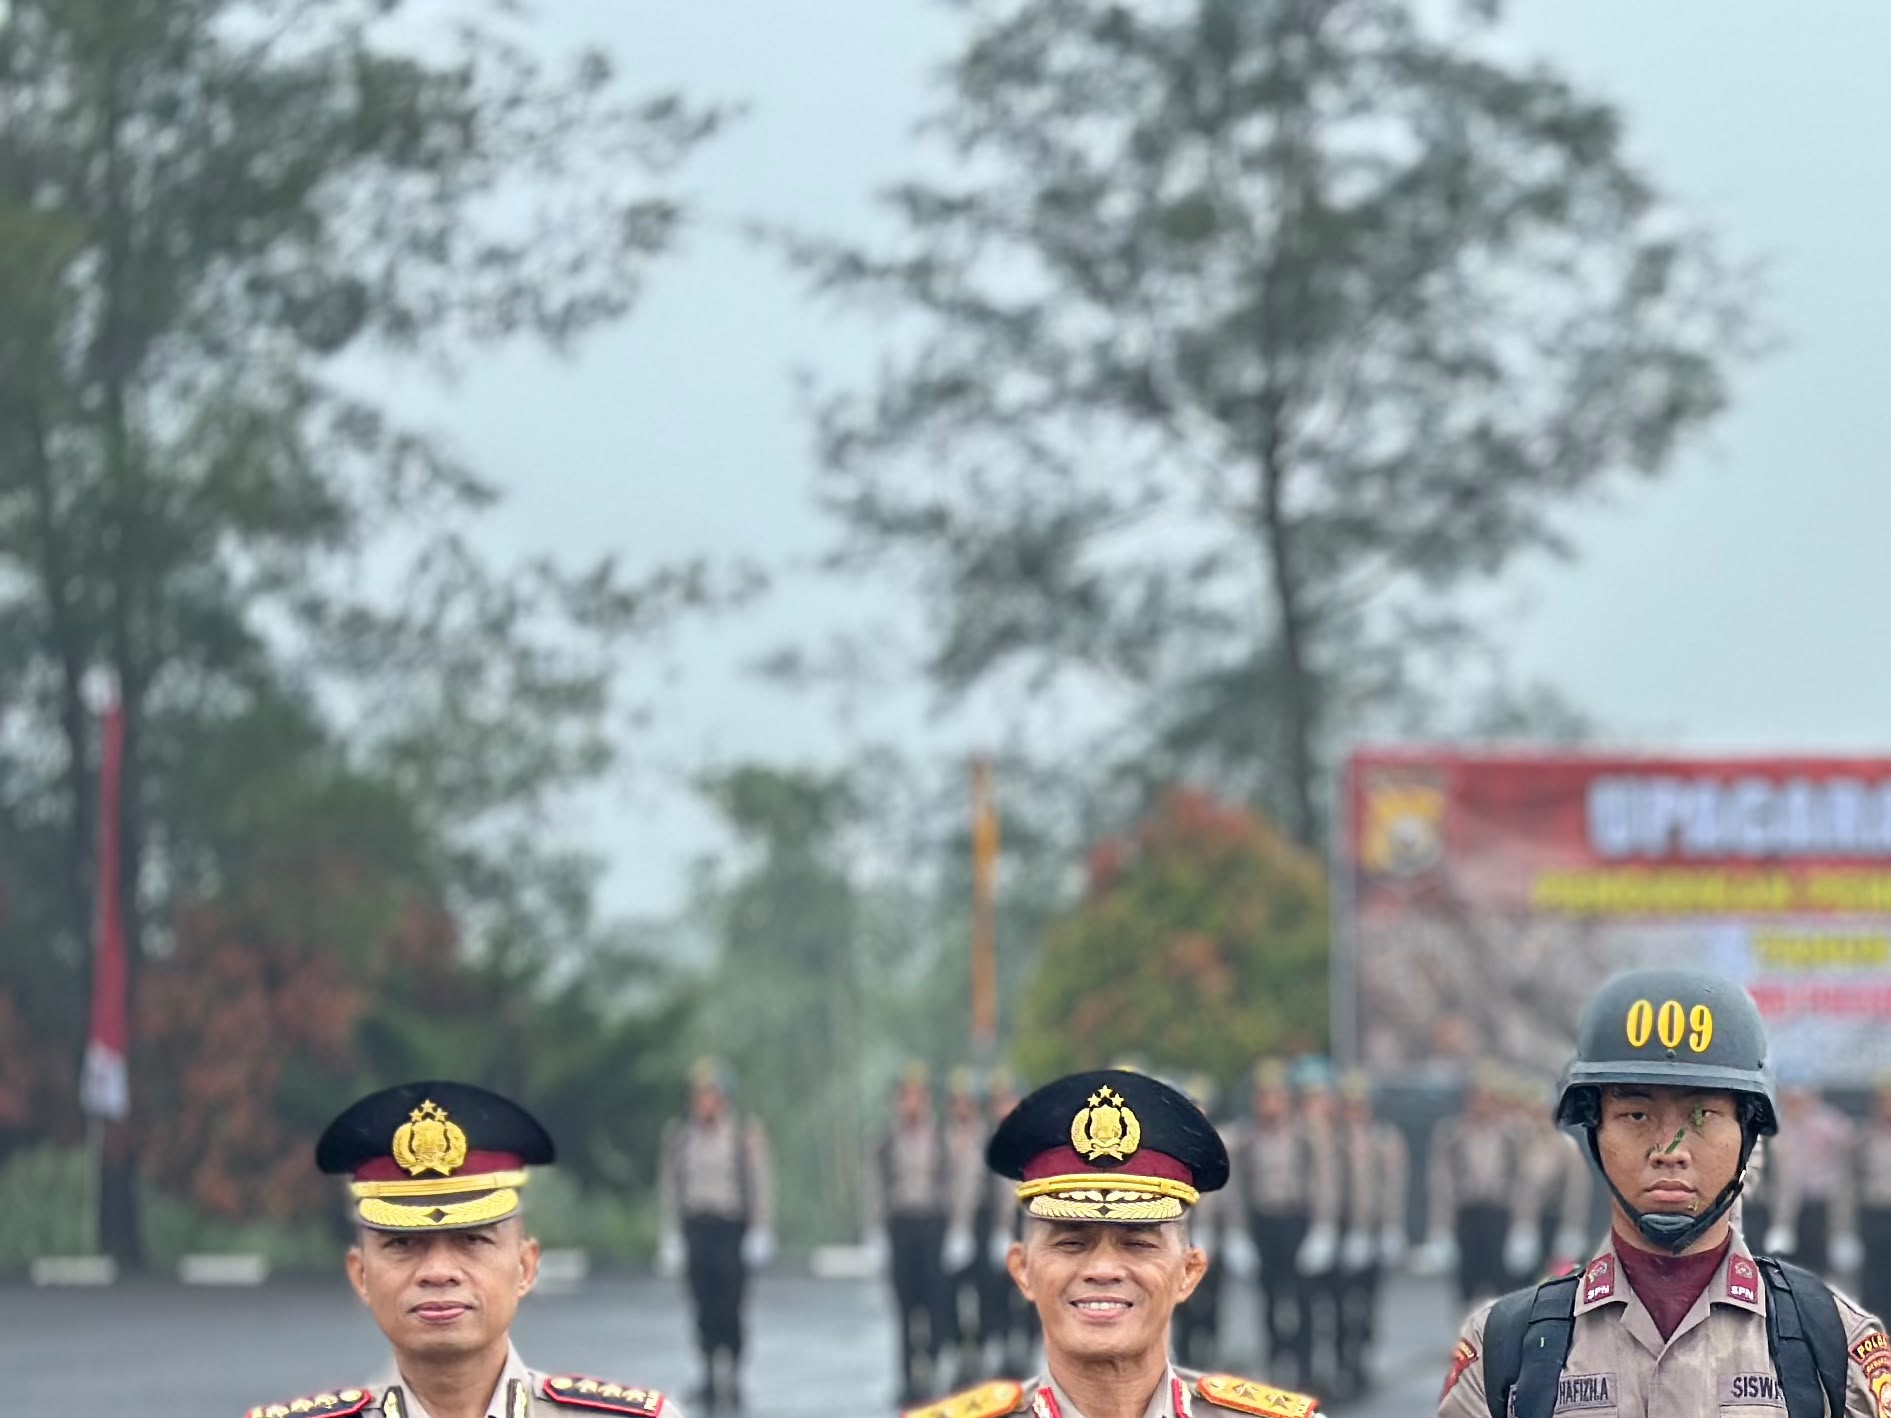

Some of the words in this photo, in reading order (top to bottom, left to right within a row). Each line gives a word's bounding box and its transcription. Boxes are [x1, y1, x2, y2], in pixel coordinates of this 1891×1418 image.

[1626, 998, 1713, 1054] 009
[1587, 1285, 1609, 1300] SPN
[1731, 1285, 1754, 1301] SPN
